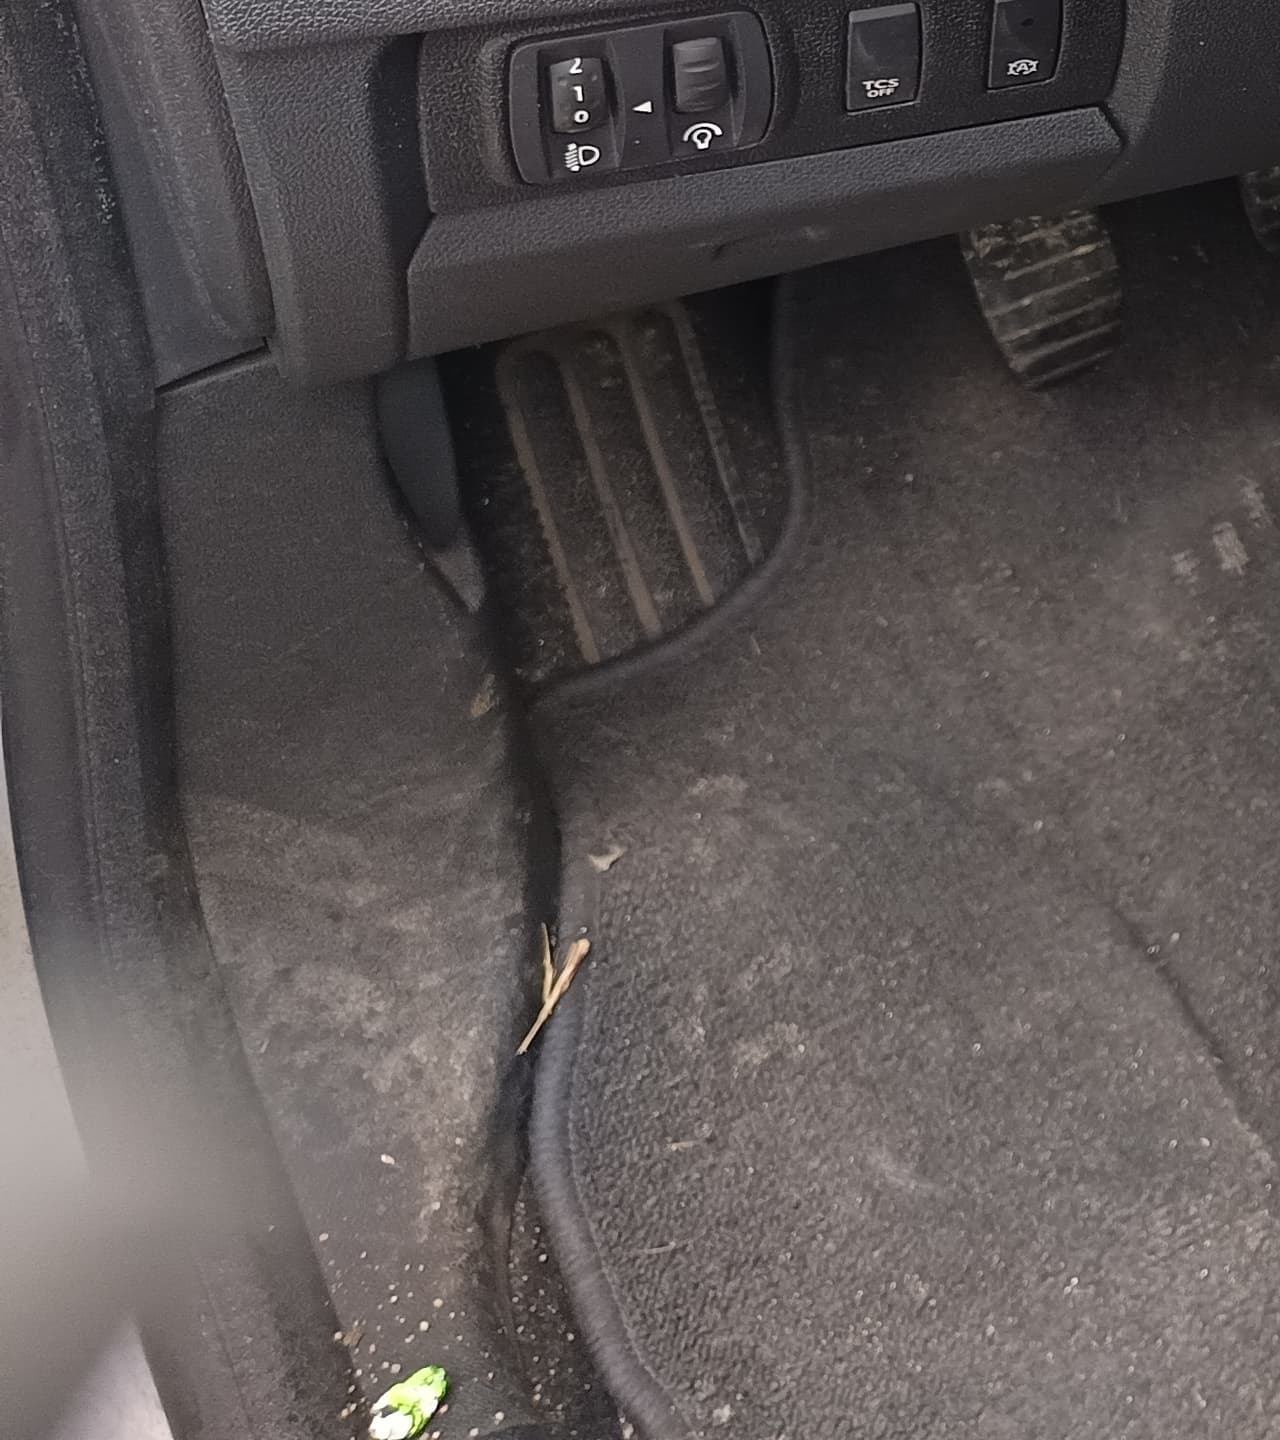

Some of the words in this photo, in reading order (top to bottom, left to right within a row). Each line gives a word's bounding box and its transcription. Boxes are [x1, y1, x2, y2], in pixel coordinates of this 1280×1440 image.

[569, 57, 583, 74] 2
[862, 78, 899, 90] TCS
[573, 85, 584, 102] 1
[867, 88, 895, 98] OFF
